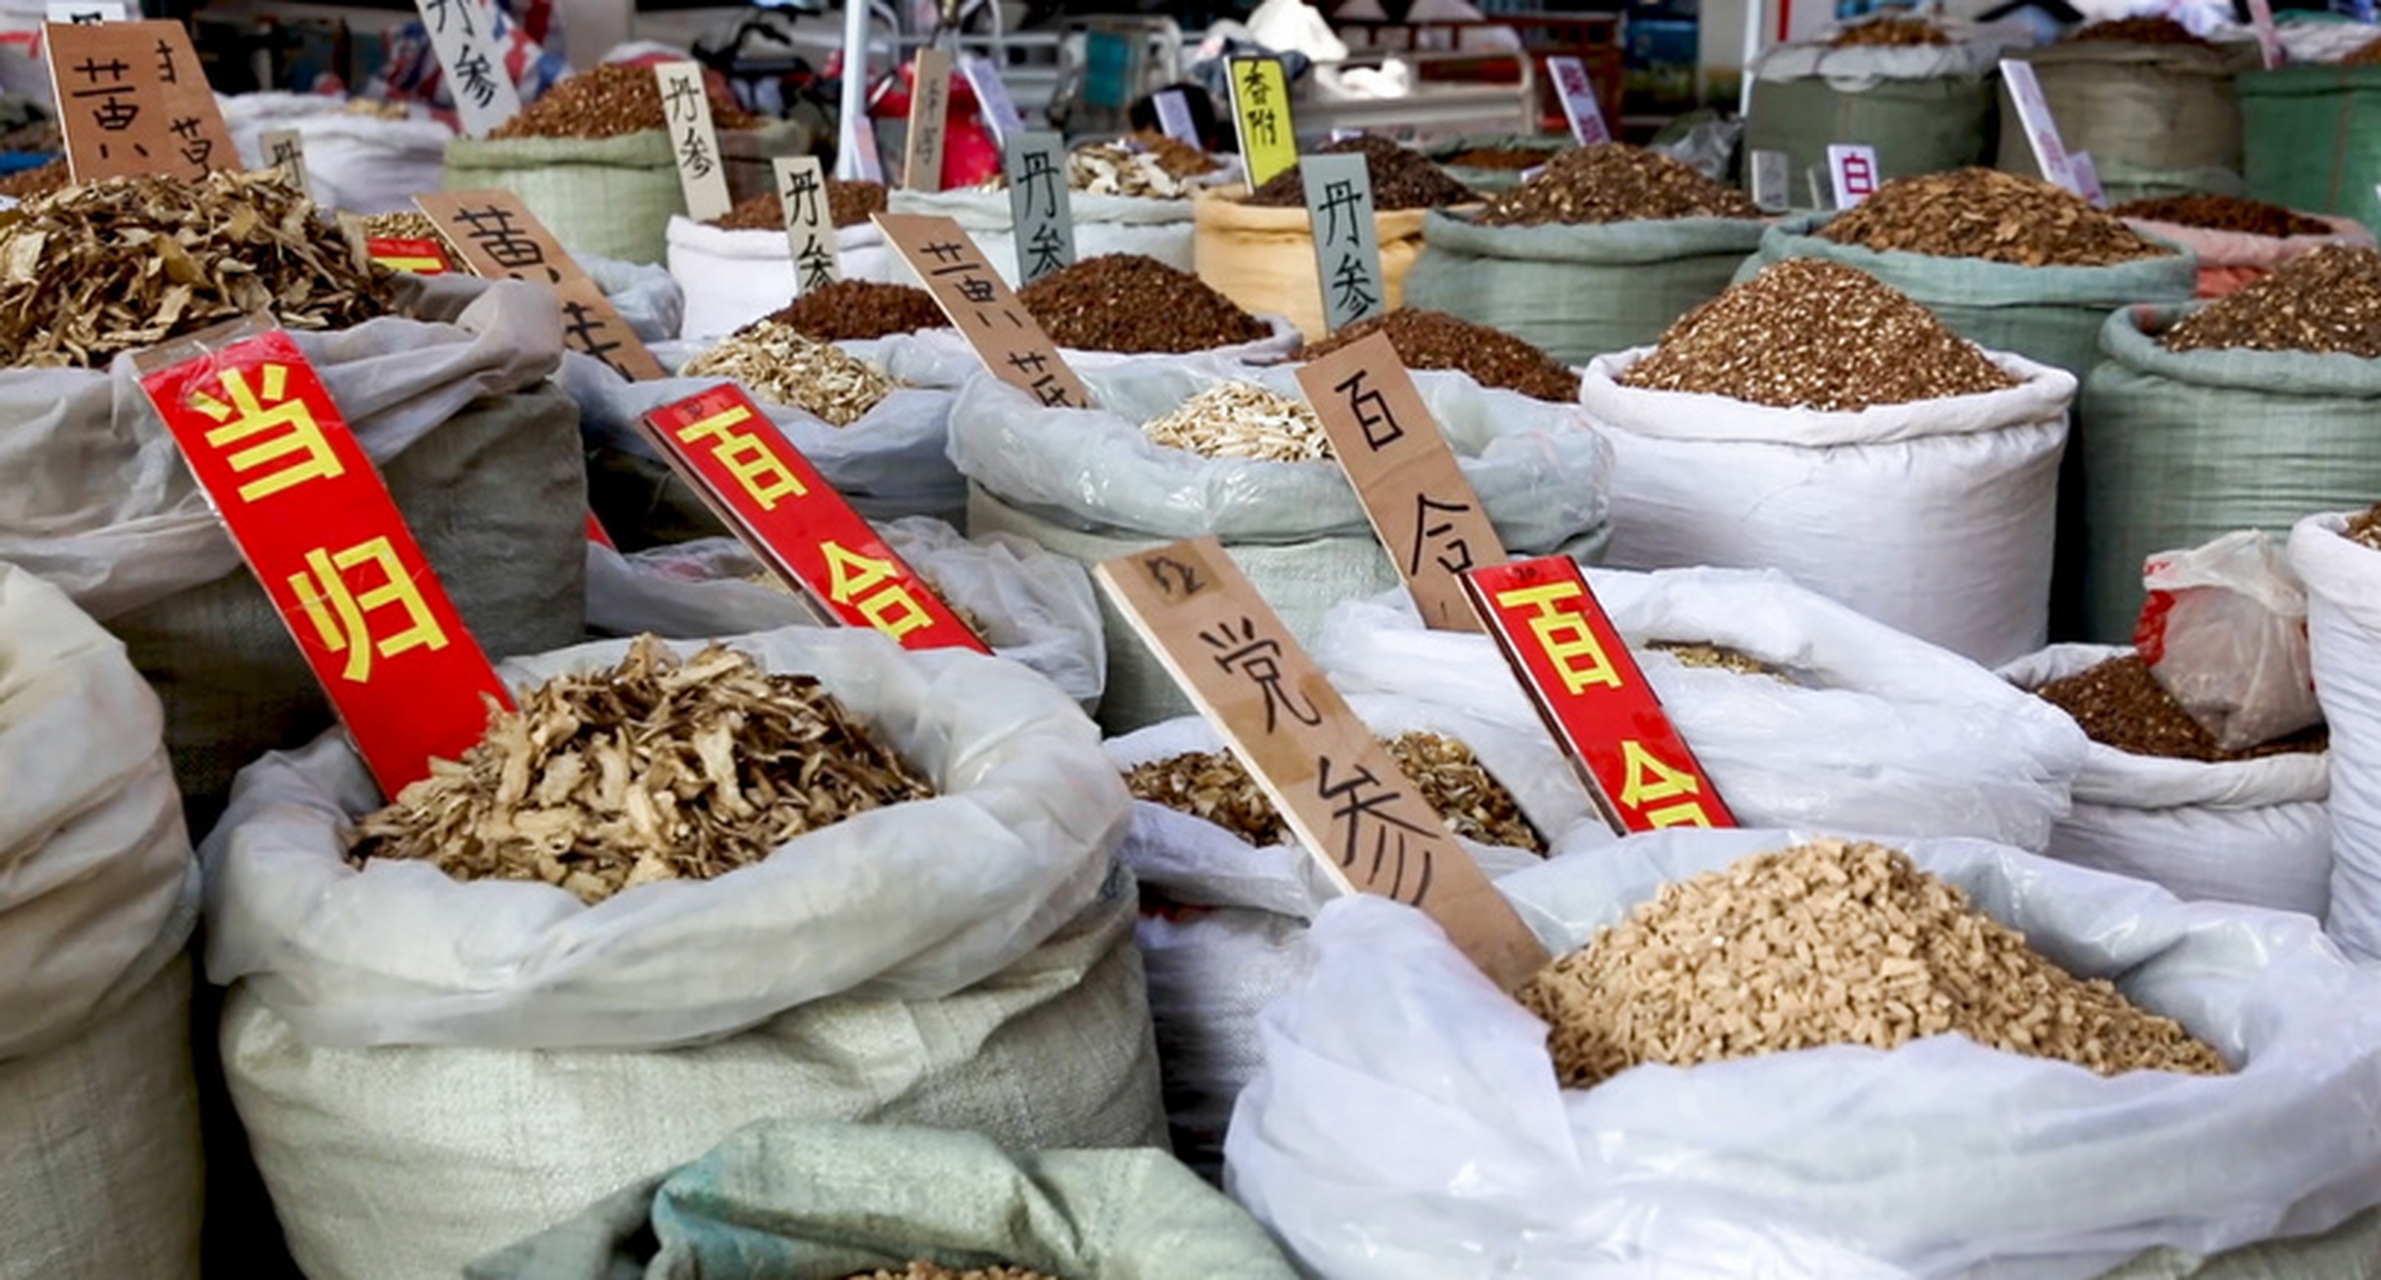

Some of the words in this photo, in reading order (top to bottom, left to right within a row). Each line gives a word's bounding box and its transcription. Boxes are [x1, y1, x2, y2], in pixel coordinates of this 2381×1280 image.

[426, 0, 499, 108] 丹参
[663, 76, 716, 180] 丹参
[1016, 151, 1067, 278] 丹参
[1317, 179, 1378, 322] 丹参
[1842, 152, 1873, 194] 白
[193, 363, 449, 684] 当归
[675, 404, 934, 643] 百合
[1335, 369, 1474, 577] 百合
[1199, 617, 1441, 906] 党参
[1496, 580, 1711, 828] 百合
